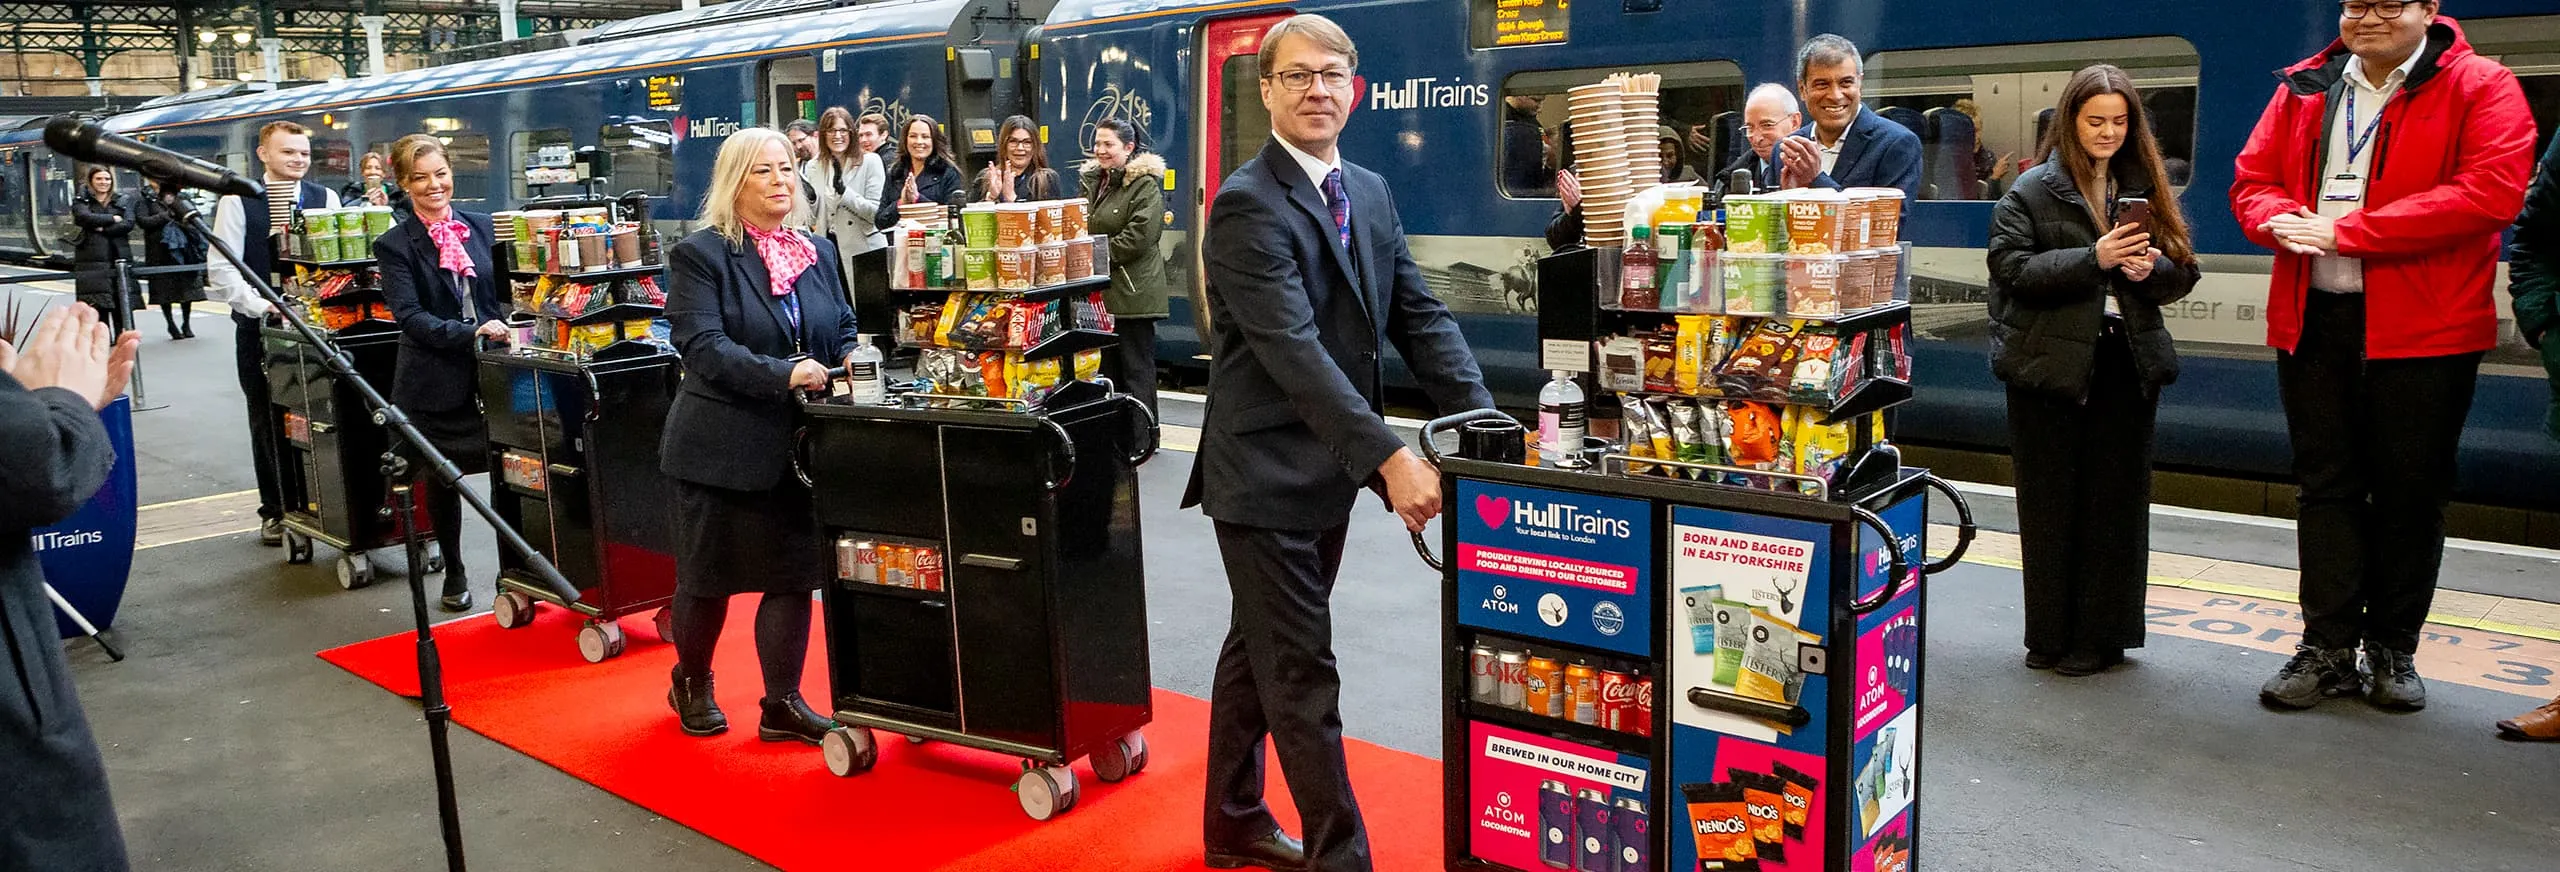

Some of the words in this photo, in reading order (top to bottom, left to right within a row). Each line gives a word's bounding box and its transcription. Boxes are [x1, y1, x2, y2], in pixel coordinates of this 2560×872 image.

[1371, 76, 1489, 110] HullTrains
[690, 117, 740, 138] HullTrains
[1514, 500, 1631, 539] HullTrains
[1515, 526, 1530, 535] Your
[1530, 528, 1547, 538] local
[1548, 530, 1561, 540] link
[1561, 532, 1570, 541] to
[1570, 535, 1596, 544] London
[1683, 532, 1718, 546] BORN
[1720, 537, 1748, 550] AND
[1751, 541, 1804, 557] BAGGED
[1476, 549, 1513, 562] PROUDLY
[1513, 555, 1548, 567] SERVING
[1548, 560, 1585, 573] LOCALLY
[1585, 565, 1625, 579] SOURCED
[1683, 547, 1697, 557] IN
[1699, 549, 1729, 562] EAST
[1731, 554, 1804, 573] YORKSHIRE
[1476, 559, 1499, 570] FOOD
[1499, 562, 1518, 573] AND
[1518, 565, 1545, 577] DRINK
[1545, 569, 1557, 579] TO
[1557, 571, 1576, 582] OUR
[1576, 573, 1628, 590] CUSTOMERS
[1481, 598, 1519, 614] ATOM
[2482, 659, 2554, 686] 3
[1491, 743, 1535, 760] BREWED
[1537, 754, 1550, 764] IN
[1552, 757, 1575, 770] OUR
[1577, 763, 1611, 778] HOME
[1614, 771, 1640, 785] CITY
[1484, 805, 1525, 825] ATOM
[1481, 819, 1532, 839] LOCOMOTION
